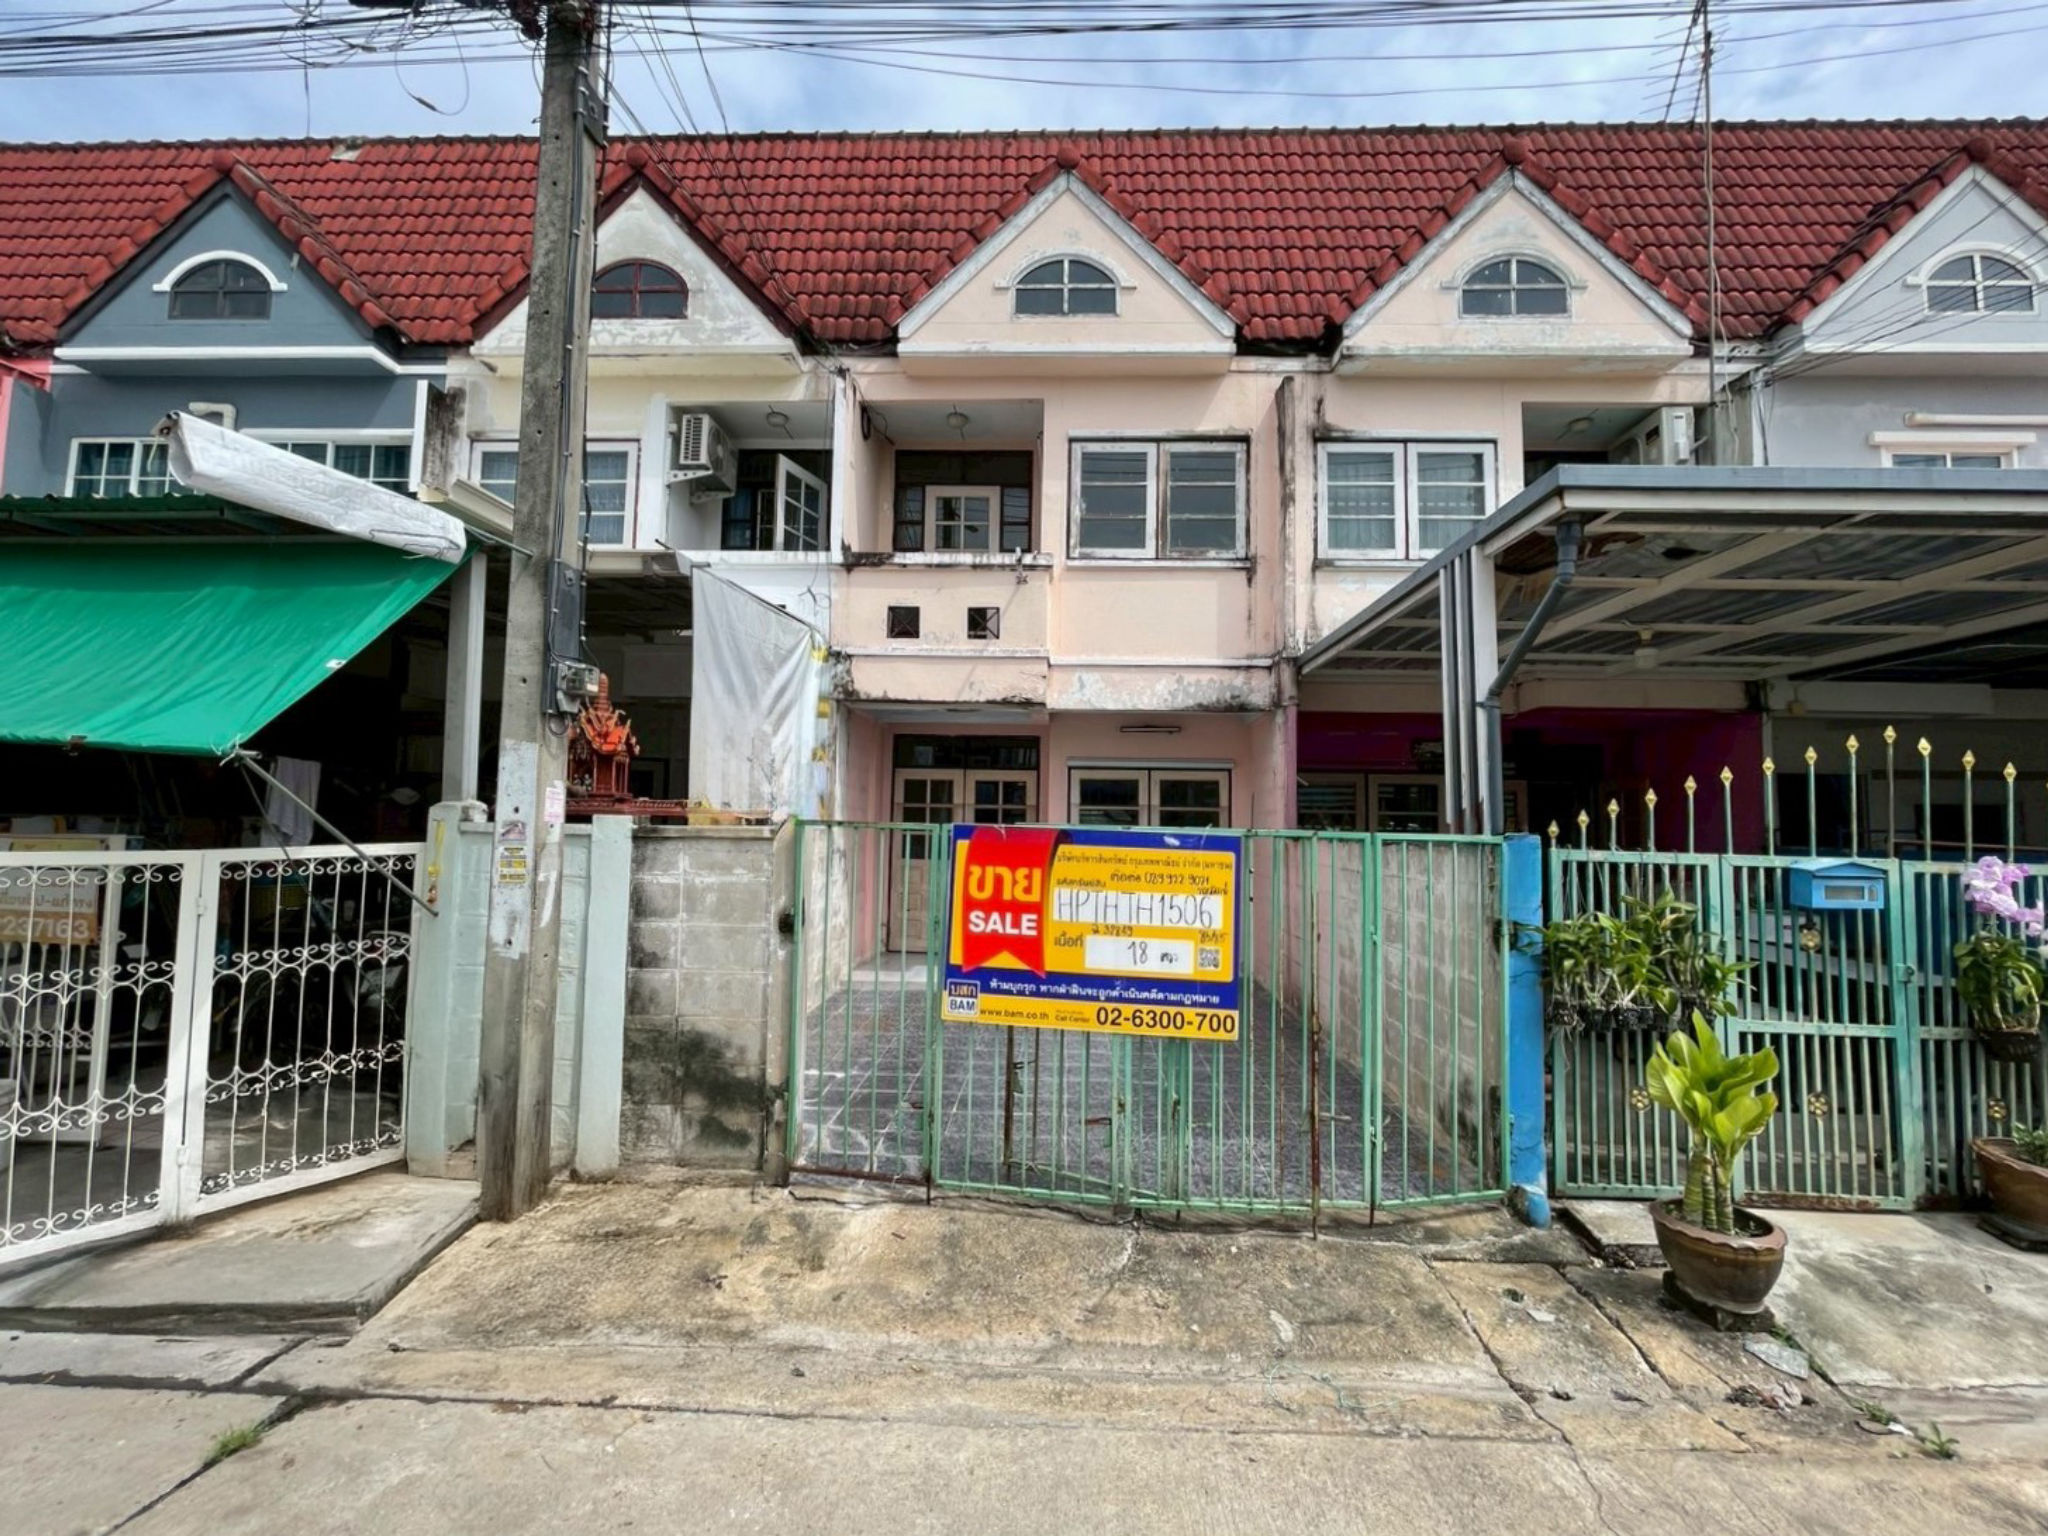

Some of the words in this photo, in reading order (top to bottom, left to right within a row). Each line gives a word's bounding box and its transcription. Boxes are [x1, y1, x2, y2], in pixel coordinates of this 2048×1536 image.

[969, 865, 1042, 902] ขาย
[0, 916, 89, 939] 237163
[969, 910, 1038, 936] SALE
[1054, 930, 1083, 948] เนื้อที่
[1127, 941, 1149, 965] 18
[951, 984, 976, 996] บสก
[990, 978, 1037, 995] ห้ามบุกรุก
[949, 999, 976, 1012] BAM
[980, 1008, 1049, 1021] www.bam.co.th
[1096, 1006, 1236, 1034] 02-6300-700
